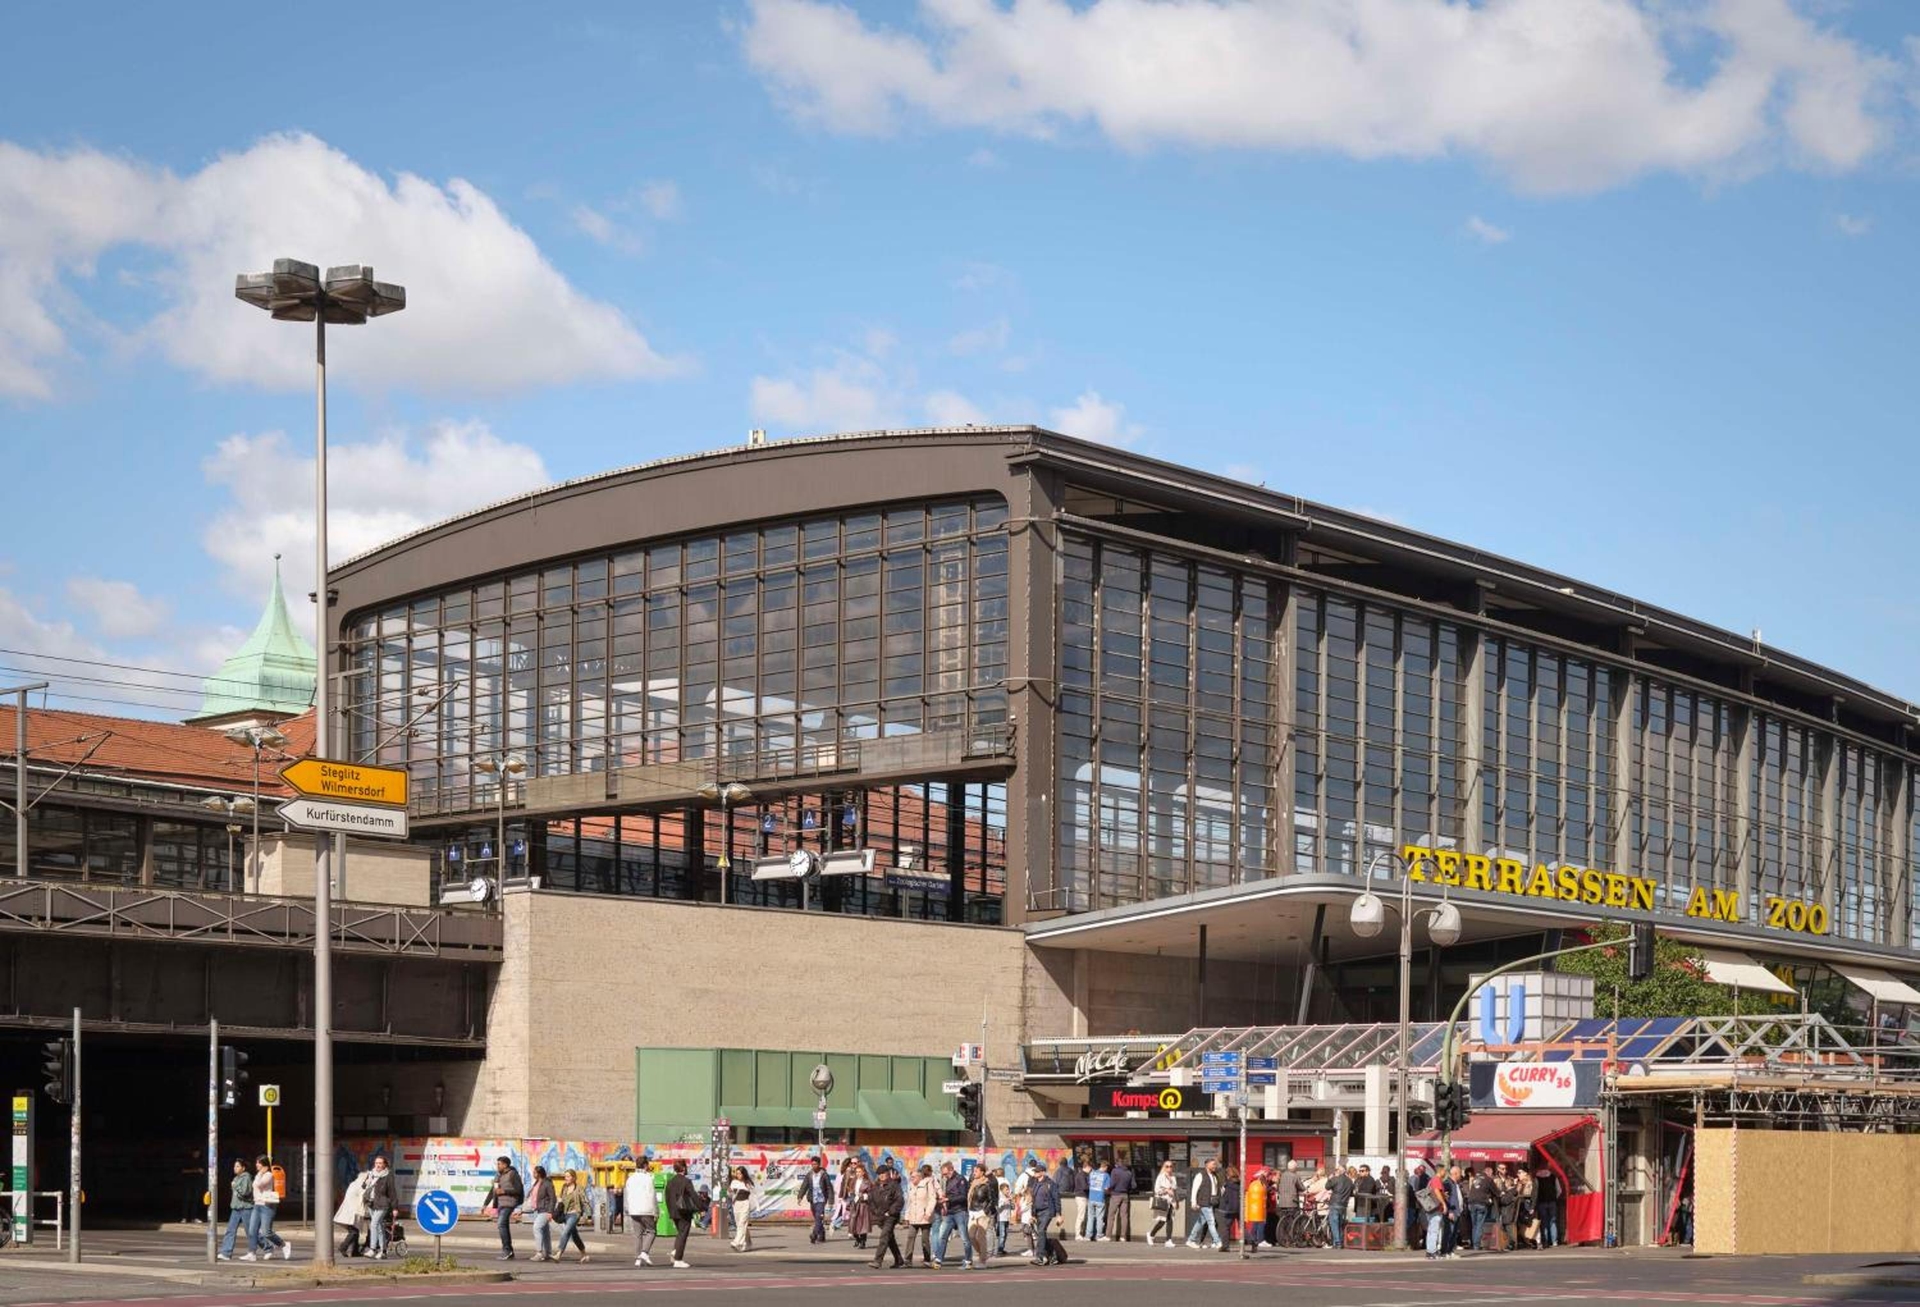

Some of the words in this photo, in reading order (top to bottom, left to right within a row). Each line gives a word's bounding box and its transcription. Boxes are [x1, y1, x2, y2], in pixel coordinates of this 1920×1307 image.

[320, 765, 361, 781] Steglitz
[321, 780, 386, 798] Wilmersdorf
[306, 807, 394, 827] Kurfürstendamm
[764, 815, 772, 828] 2
[805, 812, 814, 826] A
[449, 845, 456, 858] 4
[482, 842, 490, 854] A
[517, 839, 524, 851] 3
[1403, 844, 1657, 911] TERRASSEN
[1687, 887, 1740, 923] AM
[1767, 897, 1828, 935] ZOO
[1480, 984, 1525, 1050] U
[1508, 1066, 1558, 1083] CURRY
[1556, 1077, 1572, 1089] 36
[1112, 1091, 1159, 1111] Kamps
